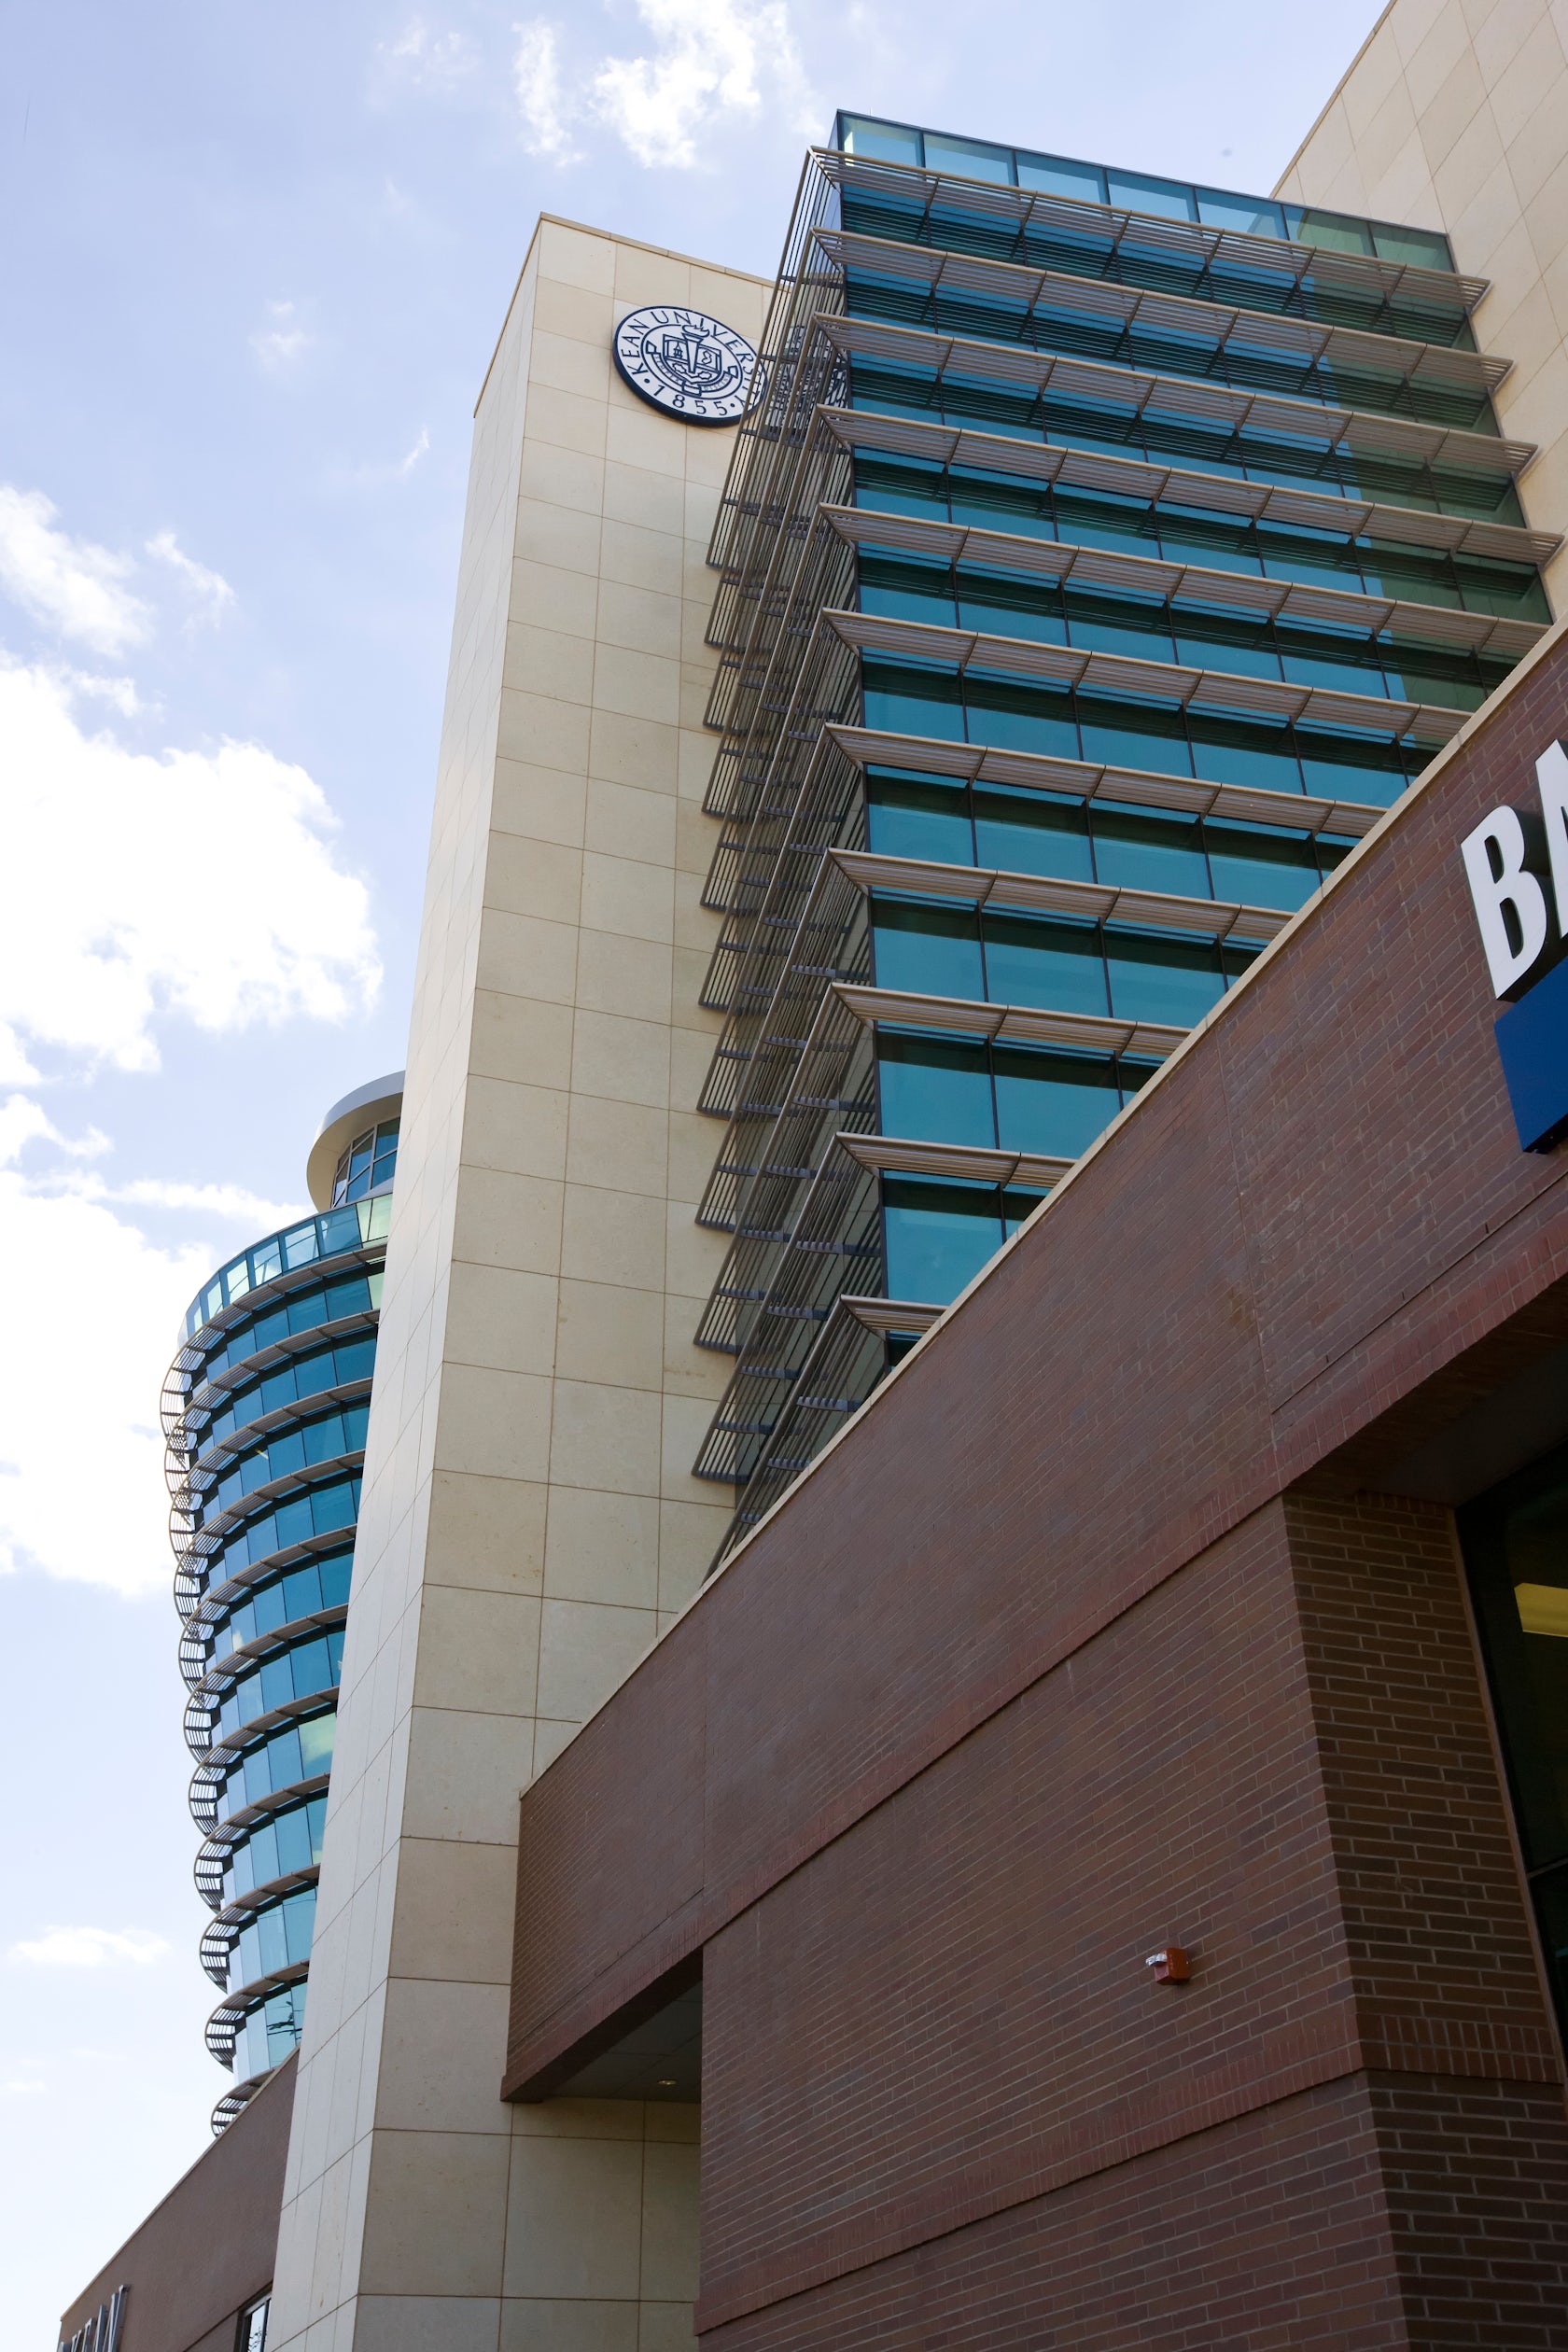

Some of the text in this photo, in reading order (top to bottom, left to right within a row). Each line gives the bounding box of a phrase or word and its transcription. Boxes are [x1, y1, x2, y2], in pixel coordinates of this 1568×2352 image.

[621, 310, 761, 408] KEAN UNIVERSITY
[653, 385, 727, 416] 1855
